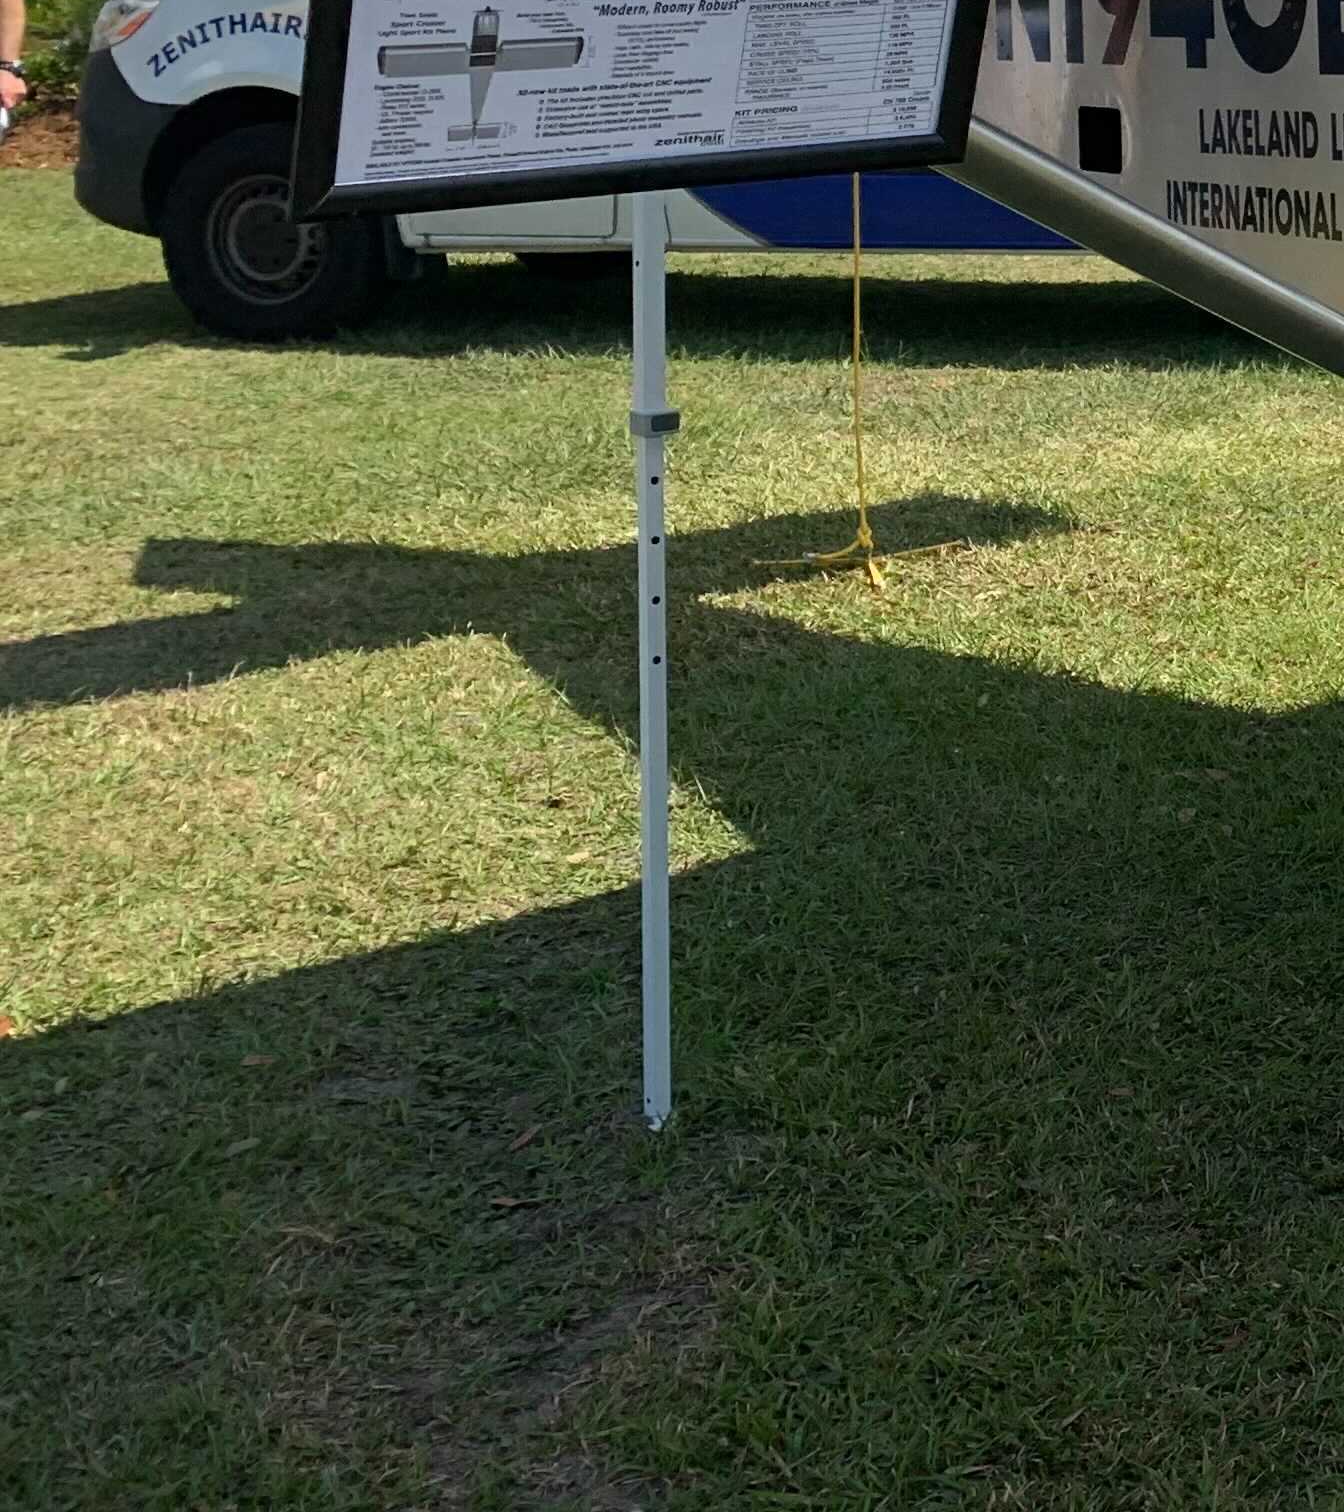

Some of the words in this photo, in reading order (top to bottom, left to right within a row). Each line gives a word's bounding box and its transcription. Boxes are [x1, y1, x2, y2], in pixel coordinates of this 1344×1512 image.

[593, 4, 649, 17] "Modern,
[653, 1, 695, 17] Roomy
[1199, 108, 1319, 160] LAKELAND
[1166, 180, 1342, 241] INTERNATIONAL
